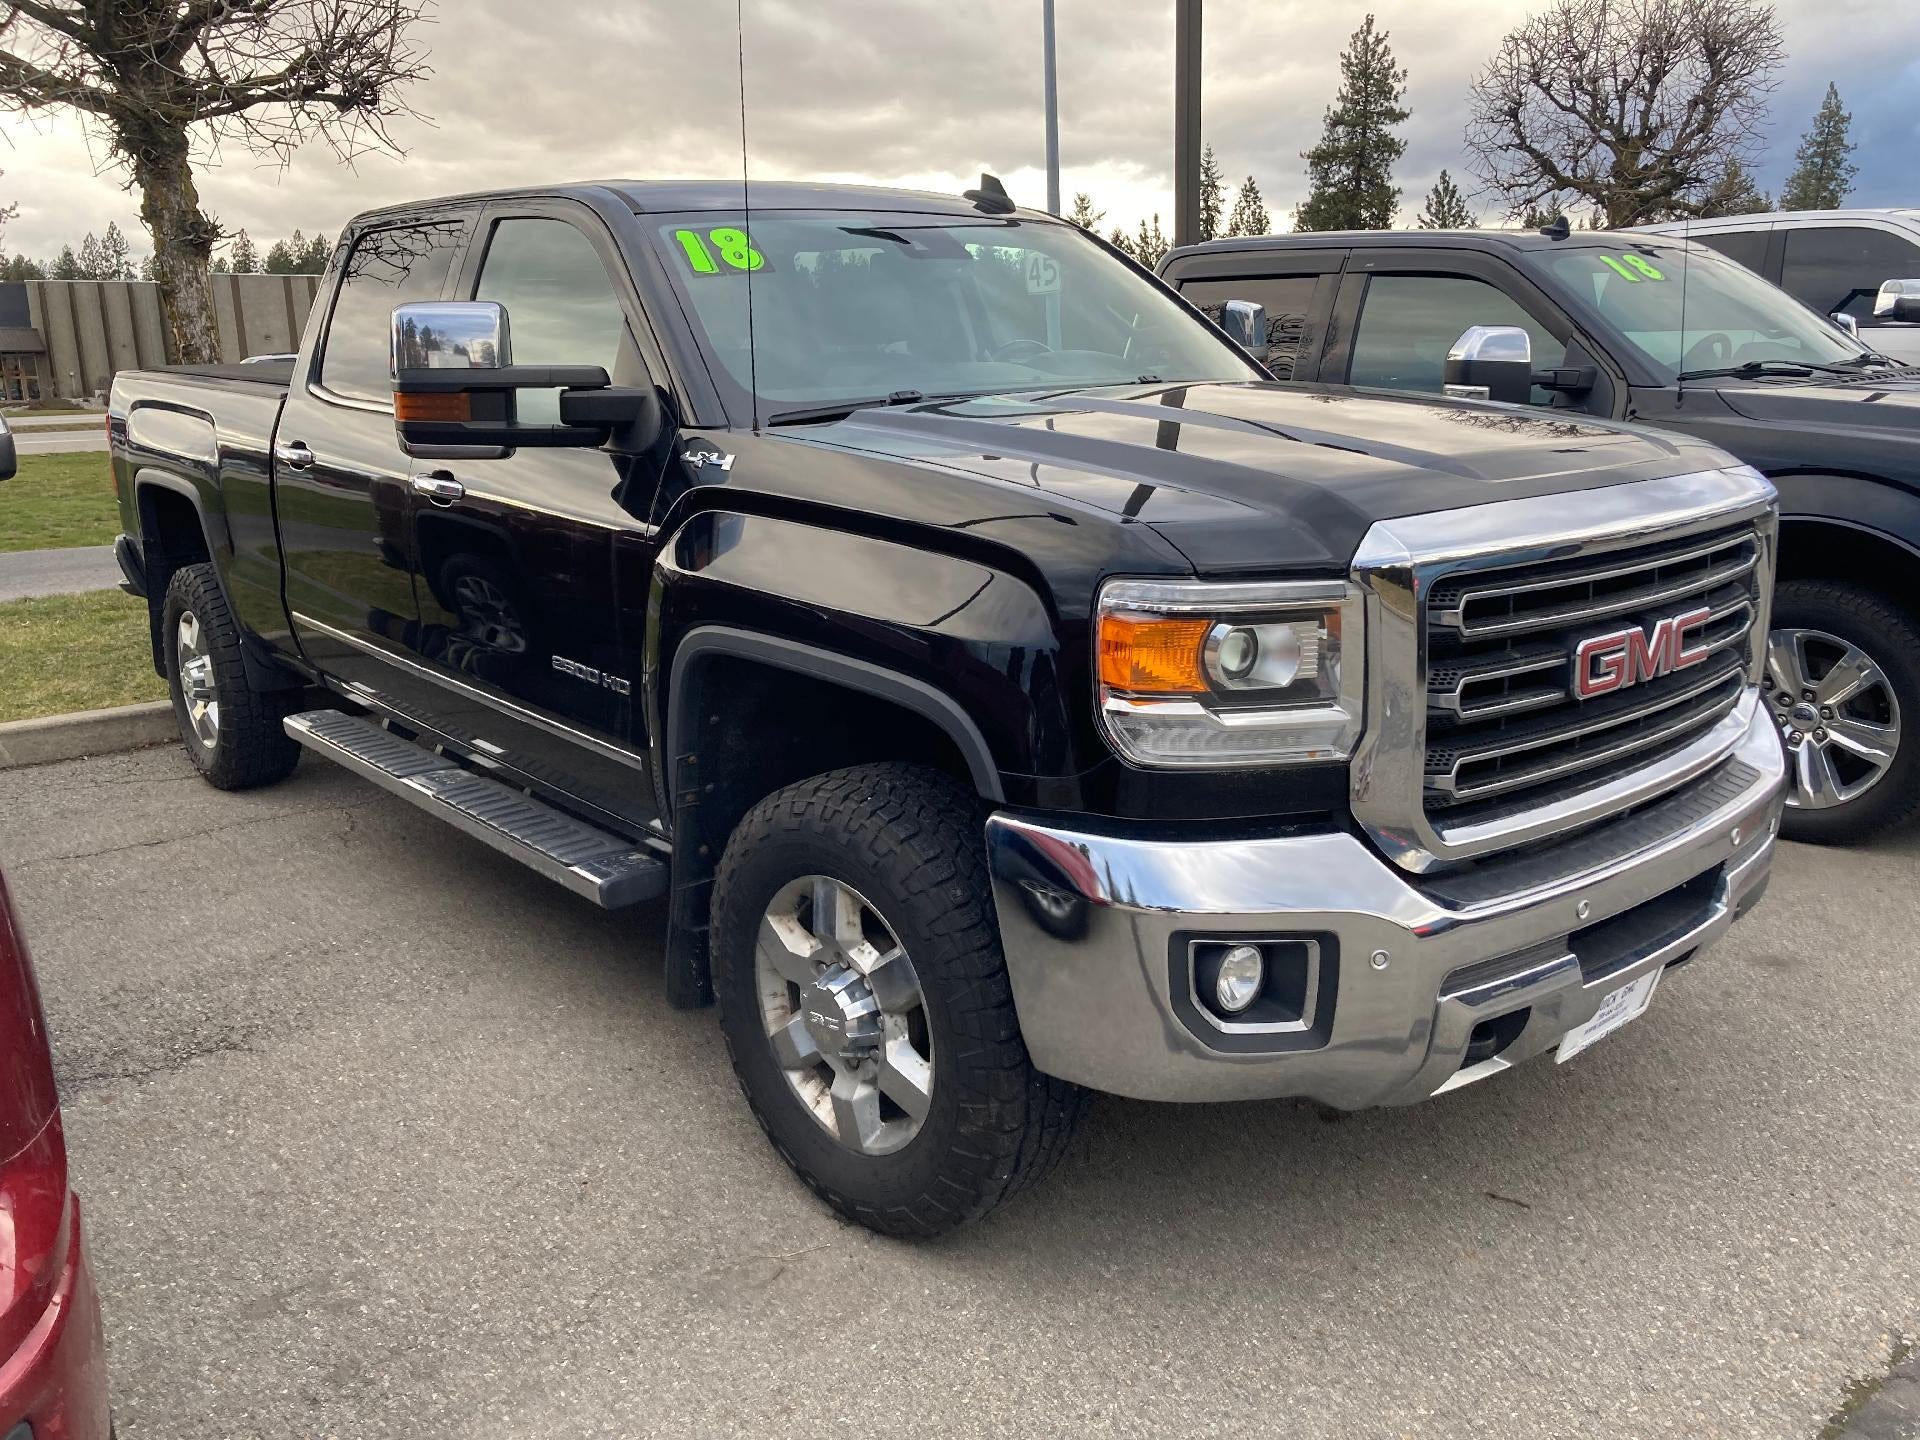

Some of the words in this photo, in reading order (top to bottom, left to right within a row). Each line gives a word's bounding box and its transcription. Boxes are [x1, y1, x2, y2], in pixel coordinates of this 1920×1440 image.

[675, 228, 764, 274] 18
[1599, 254, 1665, 282] 18
[1029, 256, 1057, 288] 45
[1575, 606, 1711, 701] GMC
[551, 655, 600, 685] 2500
[602, 672, 631, 696] HD
